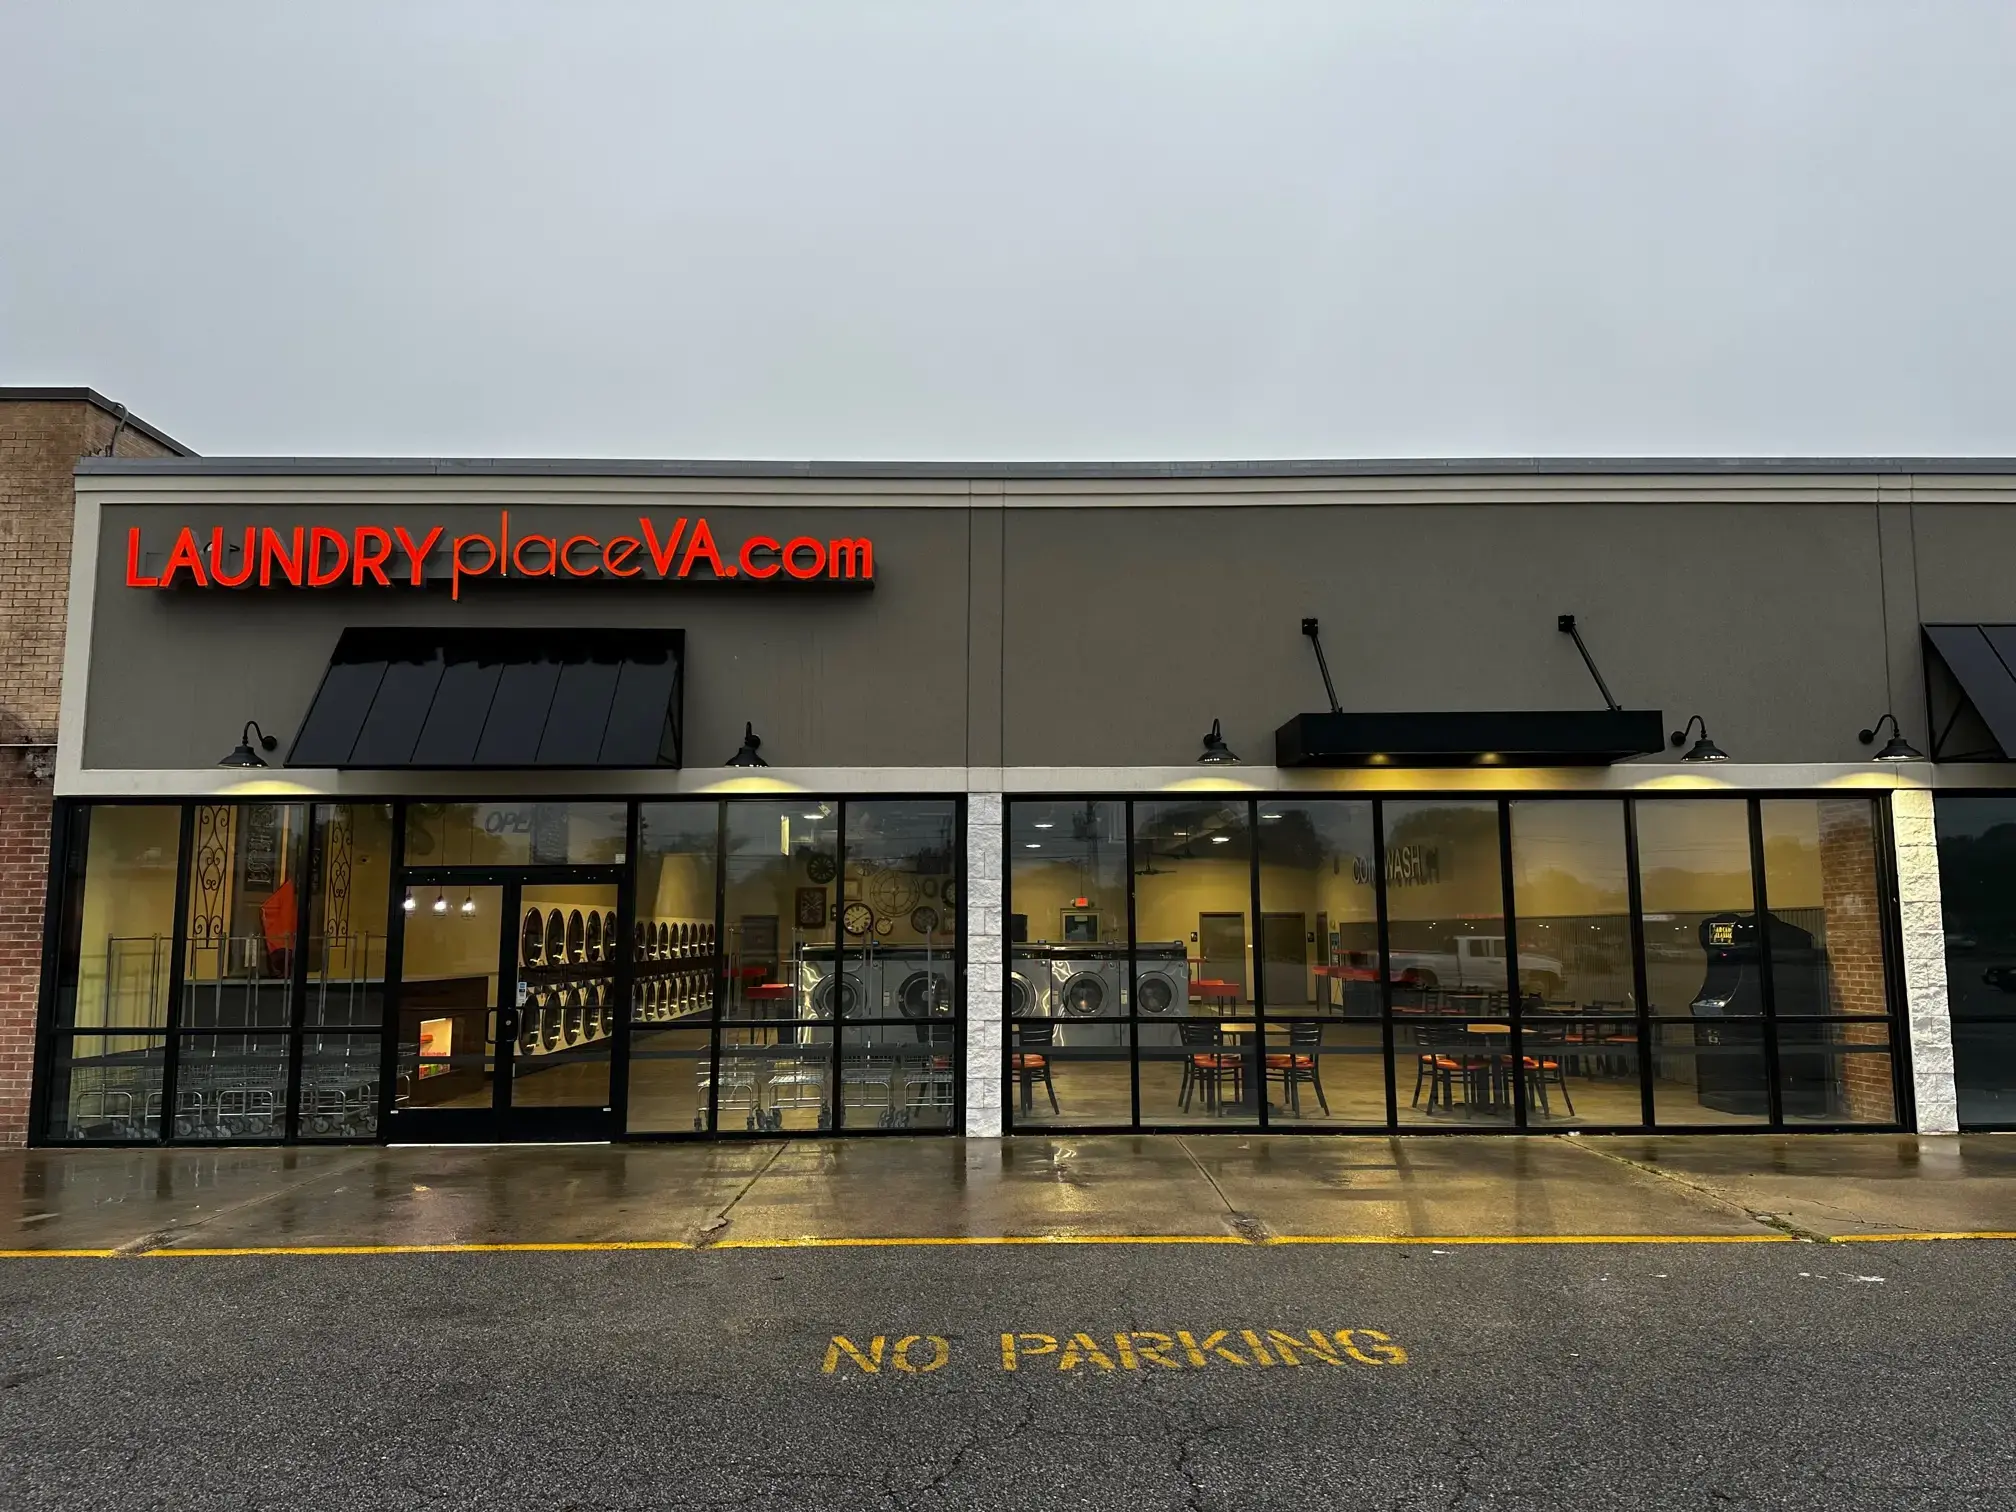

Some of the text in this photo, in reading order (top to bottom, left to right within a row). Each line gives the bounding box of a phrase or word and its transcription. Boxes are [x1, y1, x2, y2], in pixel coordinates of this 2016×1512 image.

[485, 810, 533, 834] OPE
[1384, 844, 1422, 881] WASH
[822, 1328, 1408, 1374] NO PARKING
